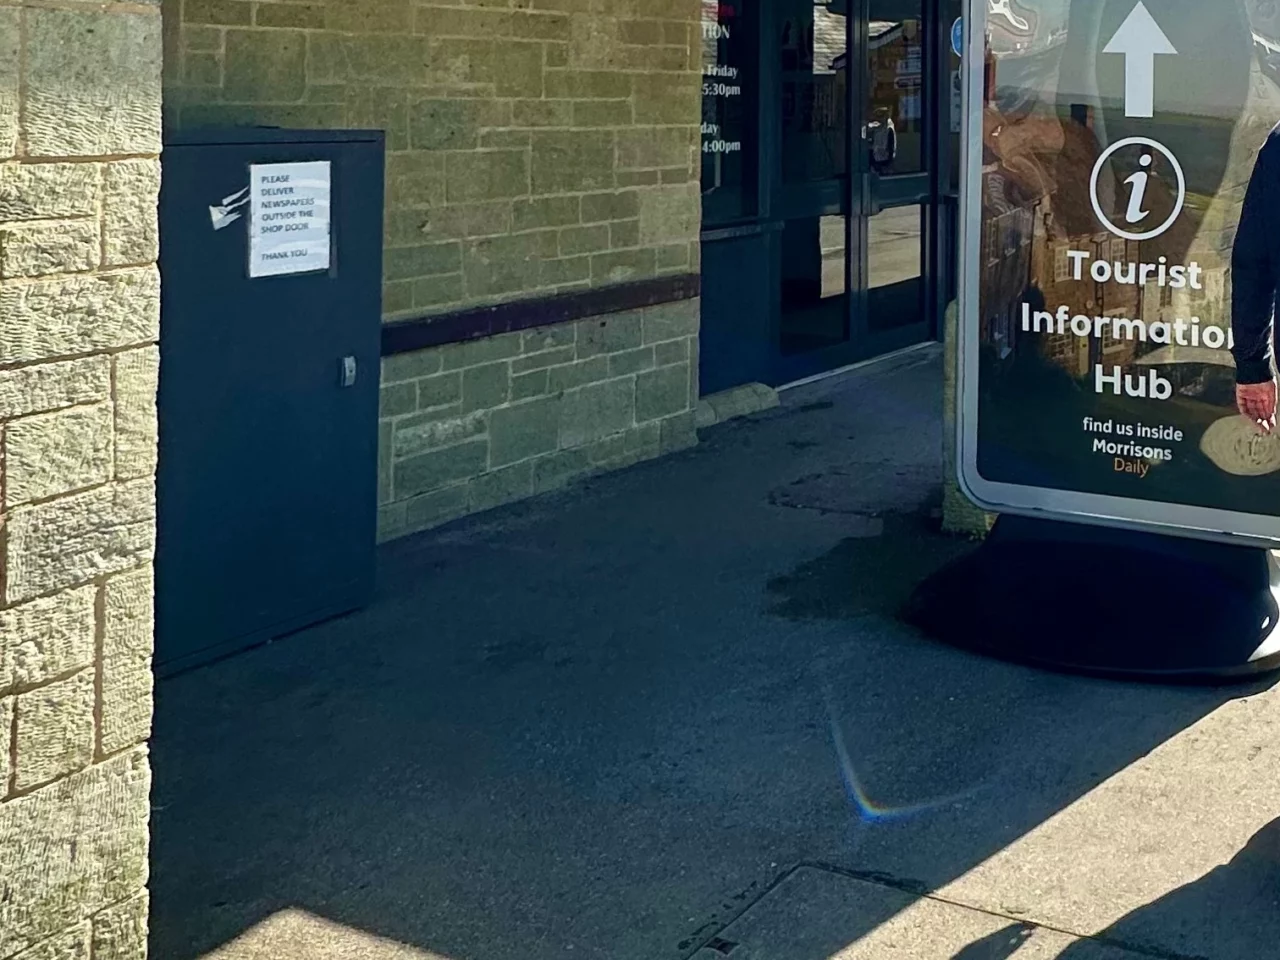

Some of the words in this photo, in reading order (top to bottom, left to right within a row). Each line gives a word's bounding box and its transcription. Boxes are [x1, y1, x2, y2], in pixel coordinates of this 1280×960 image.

[707, 64, 738, 79] Friday
[702, 83, 741, 98] 5:30pm
[701, 121, 719, 136] day
[702, 140, 741, 154] 4:00pm
[261, 175, 290, 184] PLEASE
[261, 187, 294, 196] DELIVER
[261, 198, 315, 209] NEWSPAPERS
[262, 211, 297, 221] OUTSIDE
[298, 210, 314, 218] THE
[261, 225, 283, 234] SHOP
[285, 223, 309, 232] DOOR
[262, 252, 289, 261] THANK
[290, 248, 308, 258] YOU
[1066, 249, 1202, 289] Tourist
[1094, 363, 1173, 400] Hub
[1083, 416, 1112, 434] find
[1116, 423, 1133, 436] us
[1137, 422, 1183, 441] inside
[1093, 438, 1172, 461] Morrisons
[1114, 457, 1149, 478] Daily
